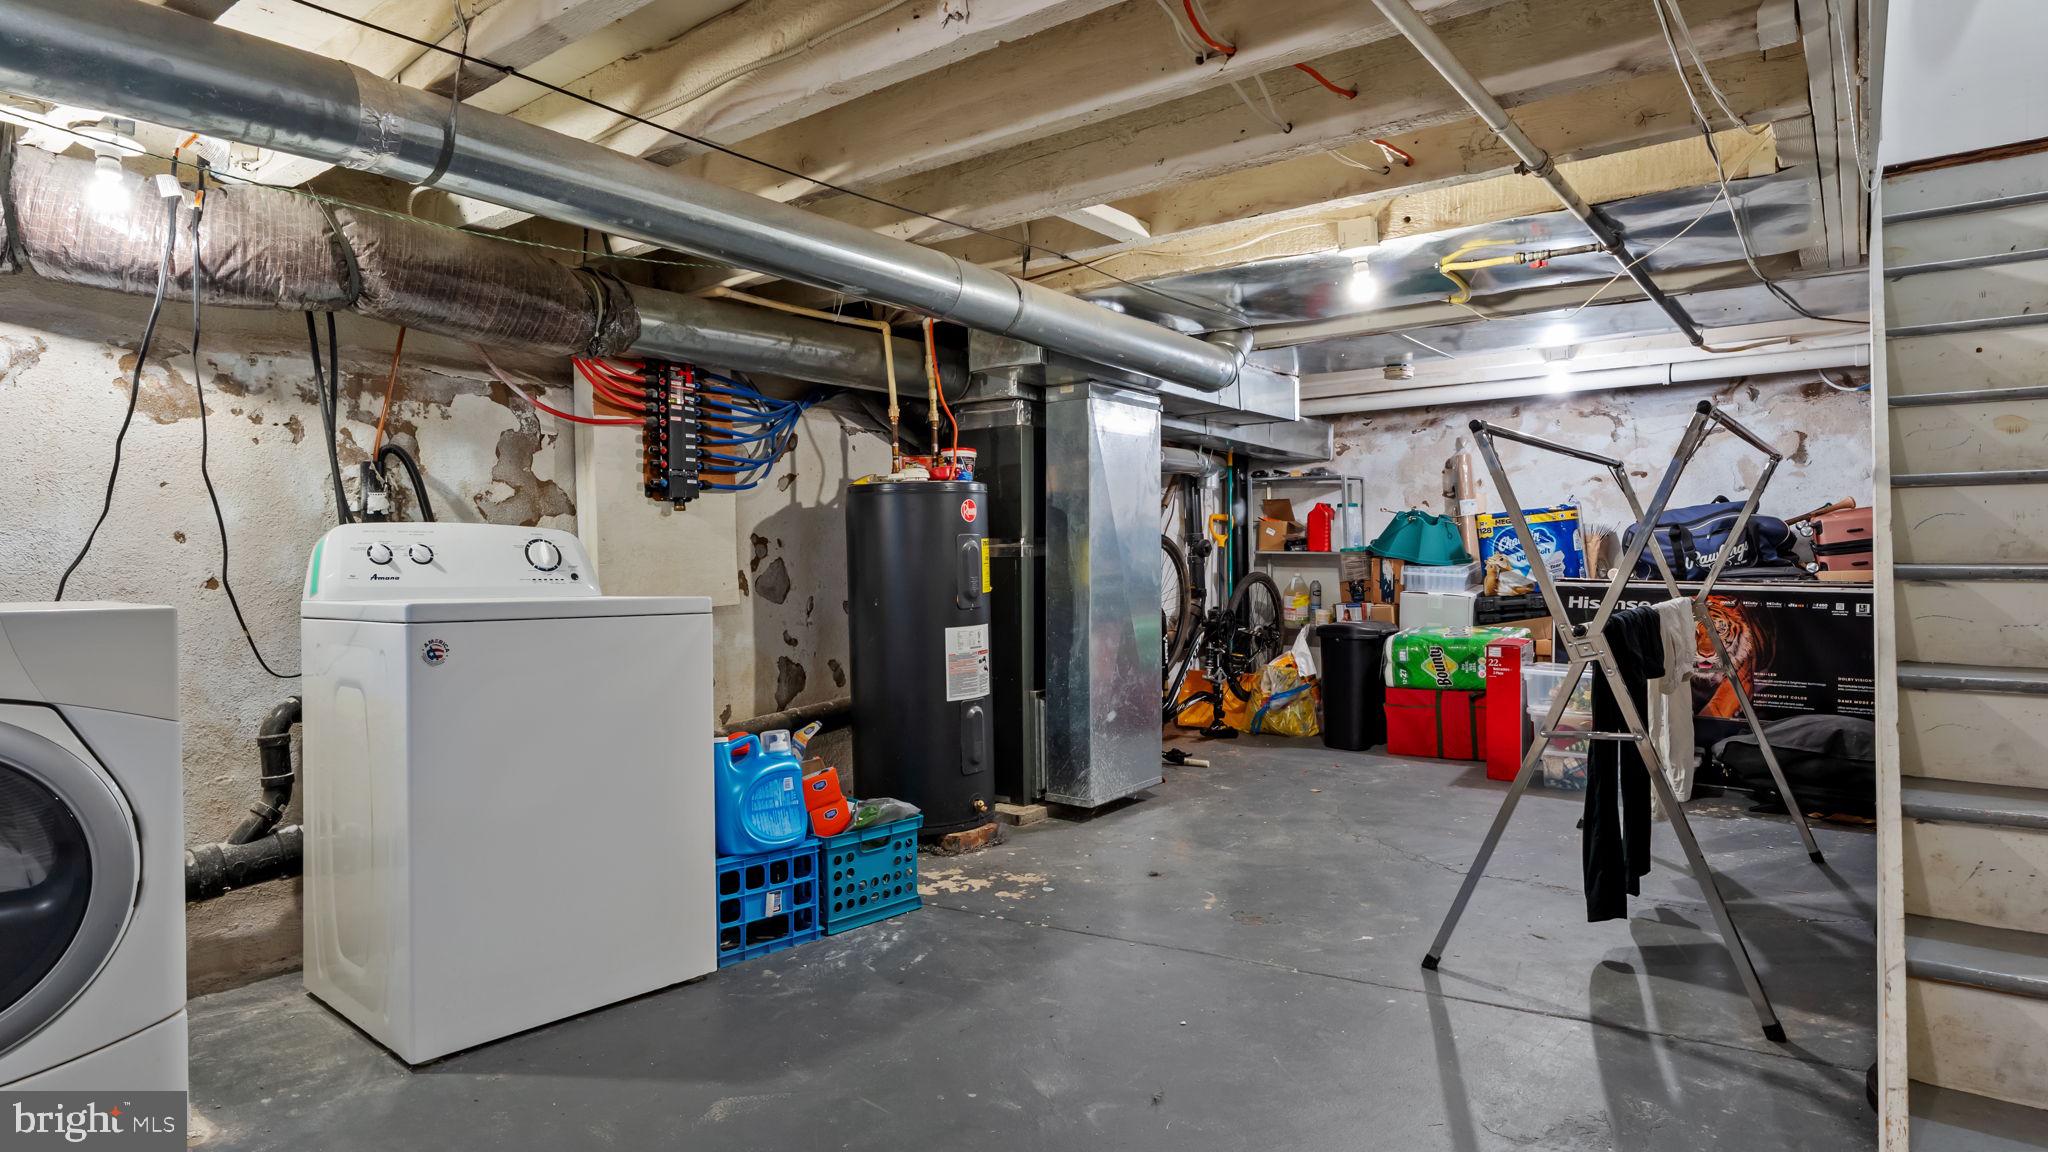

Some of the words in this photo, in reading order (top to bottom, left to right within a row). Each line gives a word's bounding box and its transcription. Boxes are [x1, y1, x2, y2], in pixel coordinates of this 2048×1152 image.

[1495, 518, 1513, 526] MEG
[370, 573, 400, 581] Amana
[1568, 595, 1652, 610] Hisnse
[1429, 645, 1454, 688] Bounty
[1488, 658, 1499, 667] 22
